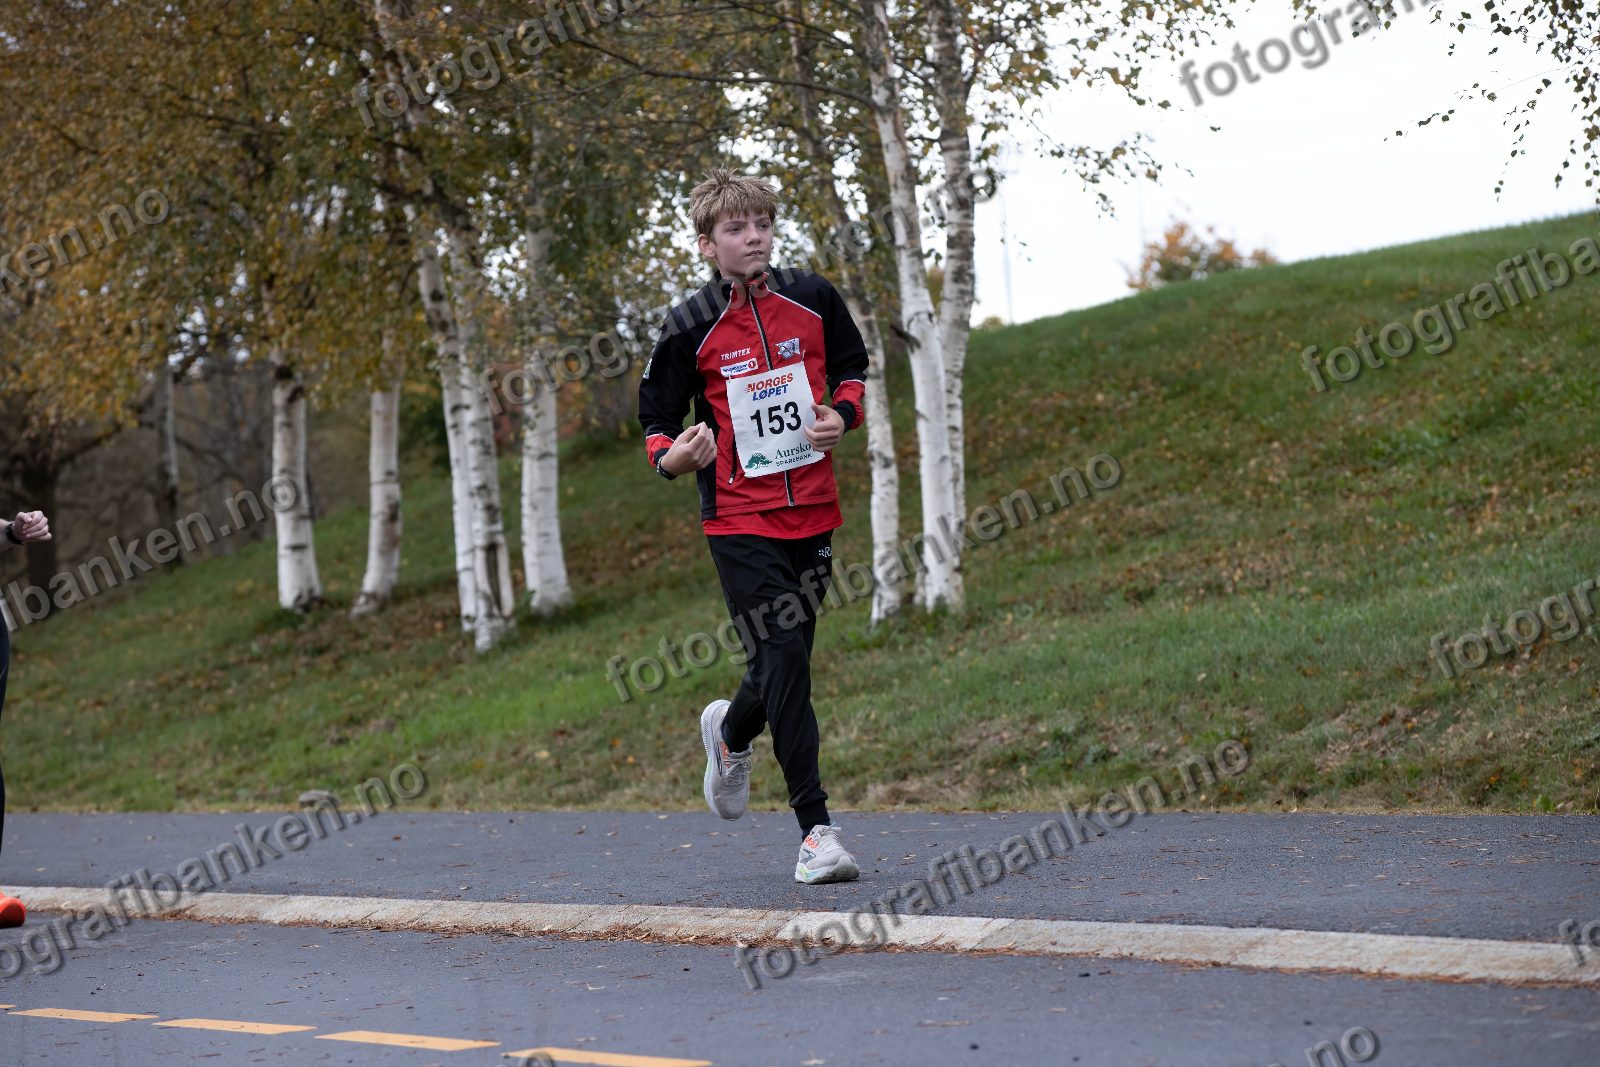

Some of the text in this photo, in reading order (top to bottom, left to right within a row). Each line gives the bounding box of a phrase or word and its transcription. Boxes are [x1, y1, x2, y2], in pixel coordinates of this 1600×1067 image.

[720, 347, 751, 361] TRIMTEX
[747, 373, 794, 392] NORGES
[752, 384, 789, 401] LØPET
[750, 401, 802, 438] 153
[775, 442, 815, 459] Aursko
